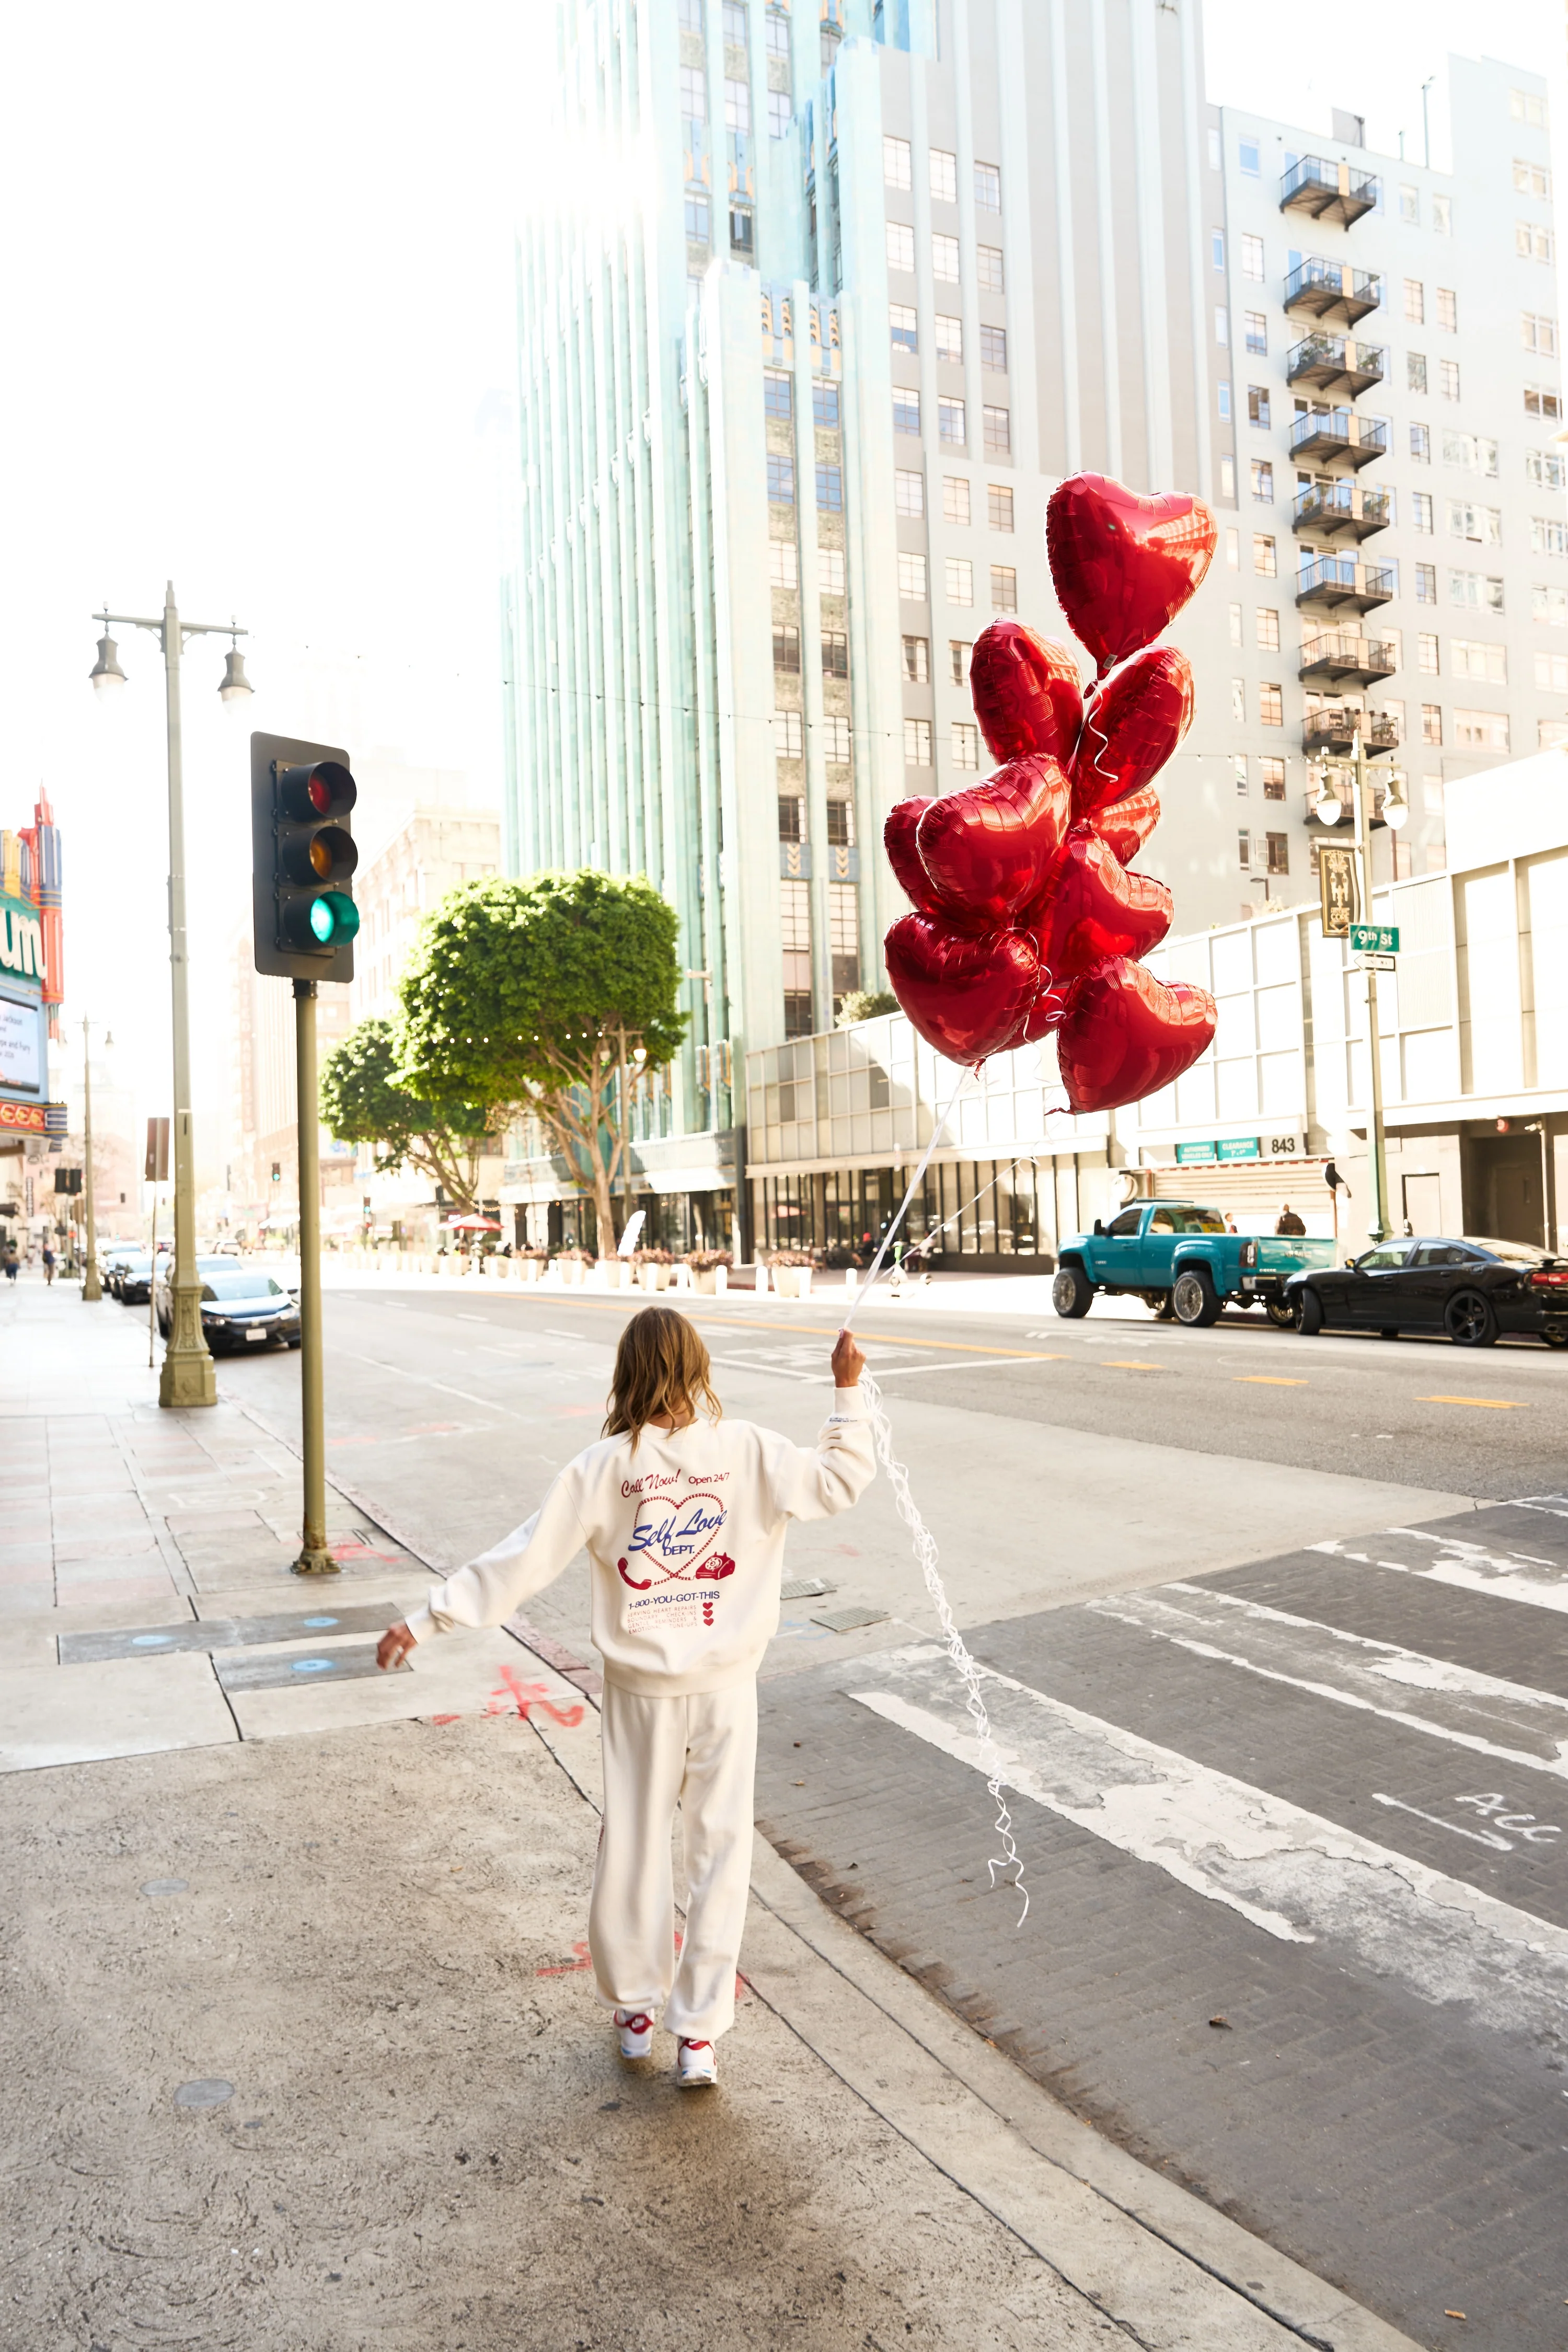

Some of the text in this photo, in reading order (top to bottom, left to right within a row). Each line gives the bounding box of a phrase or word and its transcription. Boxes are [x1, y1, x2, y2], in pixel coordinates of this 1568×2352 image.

[1357, 930, 1393, 945] 9th St
[1222, 1140, 1254, 1150] CLEARANCE
[1272, 1137, 1295, 1154] 843
[621, 1469, 681, 1498] Call Now!
[688, 1472, 730, 1485] Open 24/7
[628, 1508, 727, 1551] Self Love
[663, 1545, 695, 1556] DEPT.
[628, 1590, 720, 1610] 1-800-YOU-GOT-THIS
[627, 1609, 651, 1618] SERVING
[627, 1614, 658, 1623] BOUNDARY
[628, 1620, 649, 1629] GENTLE
[628, 1624, 662, 1634] EMOTIONAL
